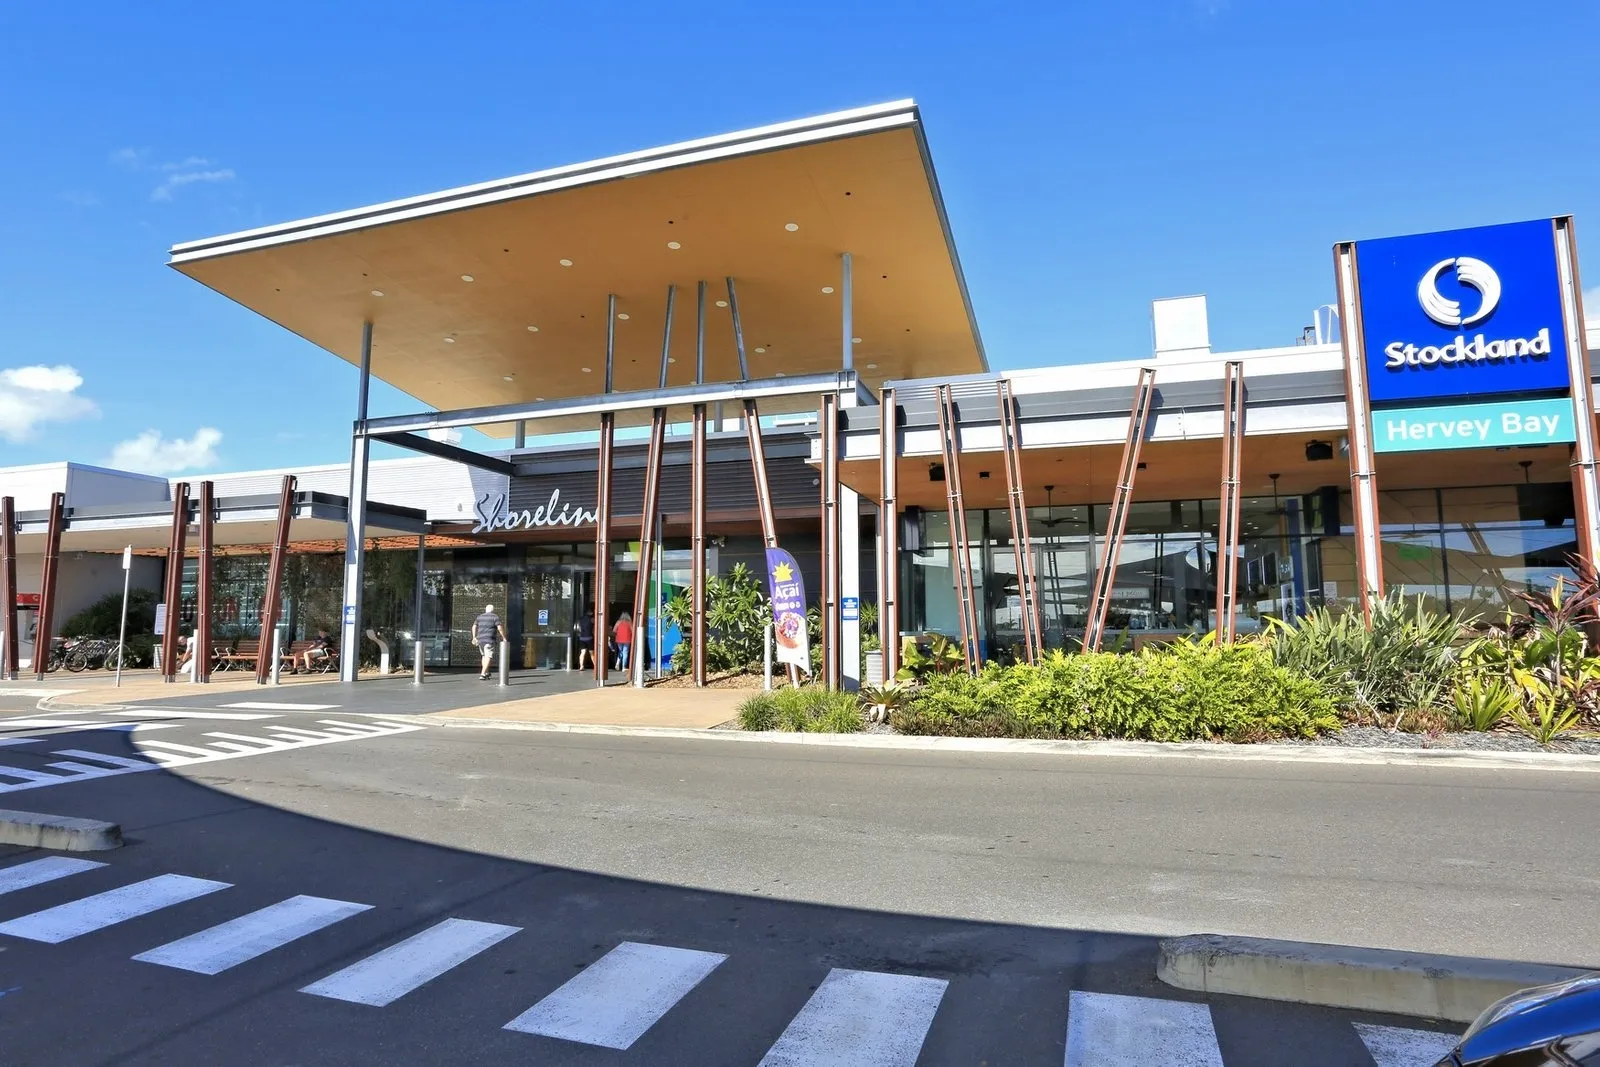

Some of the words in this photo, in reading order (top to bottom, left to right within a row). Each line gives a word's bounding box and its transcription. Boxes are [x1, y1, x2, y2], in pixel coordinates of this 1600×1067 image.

[1385, 327, 1551, 367] Stockland
[1387, 418, 1492, 442] Hervey
[1501, 412, 1560, 437] Bay
[471, 488, 599, 534] Shorelin
